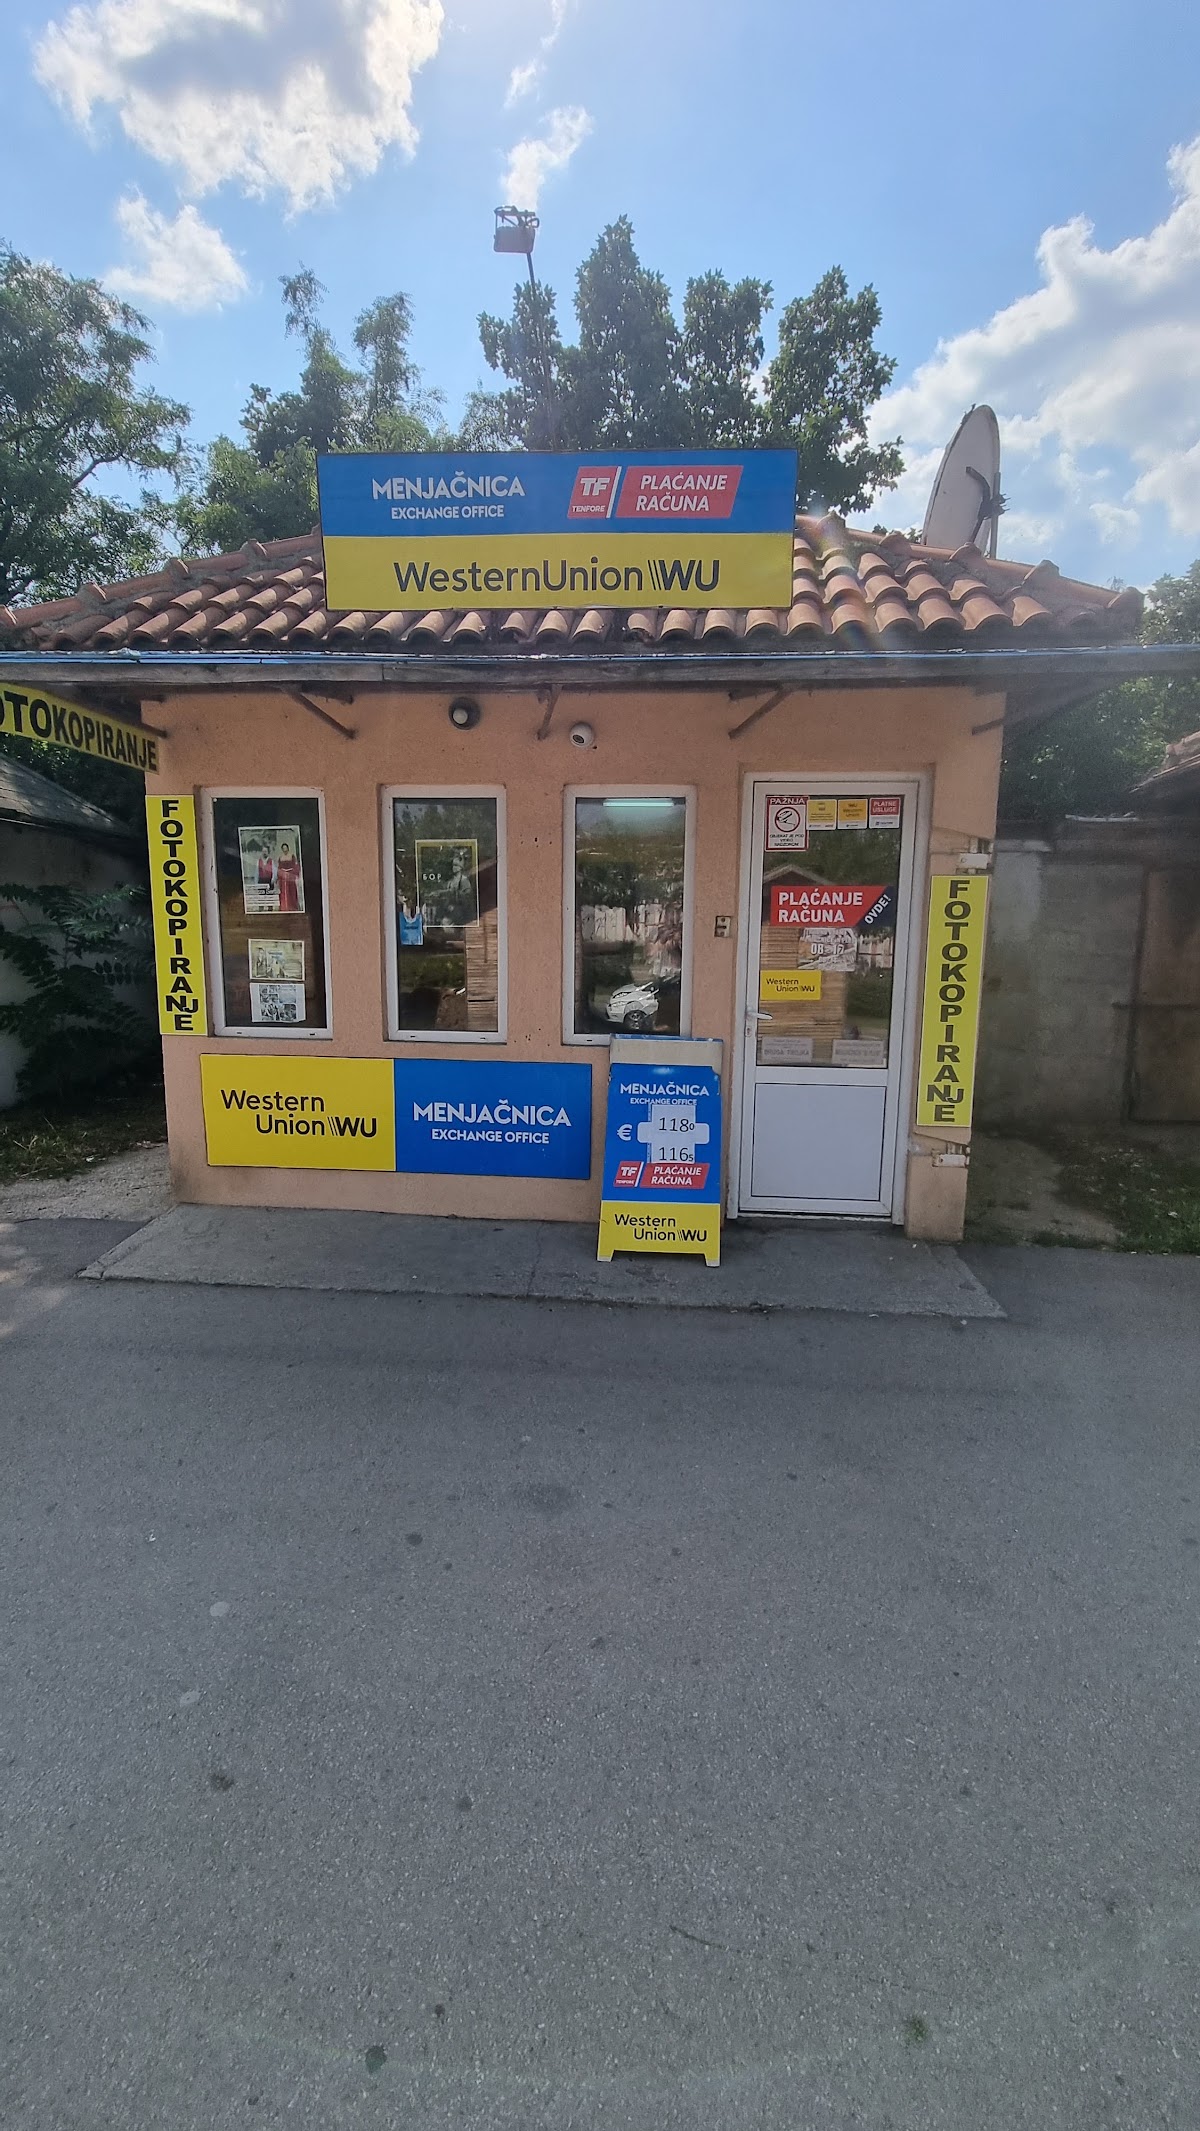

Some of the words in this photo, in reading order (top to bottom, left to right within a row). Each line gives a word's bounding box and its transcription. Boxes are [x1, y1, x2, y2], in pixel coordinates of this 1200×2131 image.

[371, 470, 526, 501] MENJAČNICA
[580, 477, 611, 496] TF
[640, 472, 728, 491] PLAĆANJE
[572, 505, 606, 513] TENFORE
[635, 491, 710, 512] RAČUNA
[391, 506, 460, 520] EXCHANGE
[462, 504, 505, 518] OFFICE
[0, 690, 157, 771] TOKOPIRANJE
[770, 797, 806, 805] PAŽNJA
[778, 888, 864, 906] PLAĆANJE
[160, 799, 200, 1032] FOTOKOPIRANJE
[778, 905, 845, 923] RAČUNA
[864, 893, 892, 925] OVDE!
[926, 879, 971, 1123] FOTOKOPIRANJE
[620, 1082, 710, 1096] MENJAČNICA
[220, 1089, 325, 1112] Western
[630, 1097, 671, 1105] EXCHANGE
[413, 1099, 572, 1127] MENJAČNICA
[256, 1113, 325, 1136] Union
[431, 1128, 502, 1143] EXCHANGE
[504, 1130, 550, 1144] OFFICE
[621, 1167, 638, 1176] TF
[653, 1166, 702, 1175] PLAĆANJE
[651, 1175, 693, 1185] RAČUNA
[614, 1213, 676, 1228] Western
[633, 1228, 676, 1241] Union
